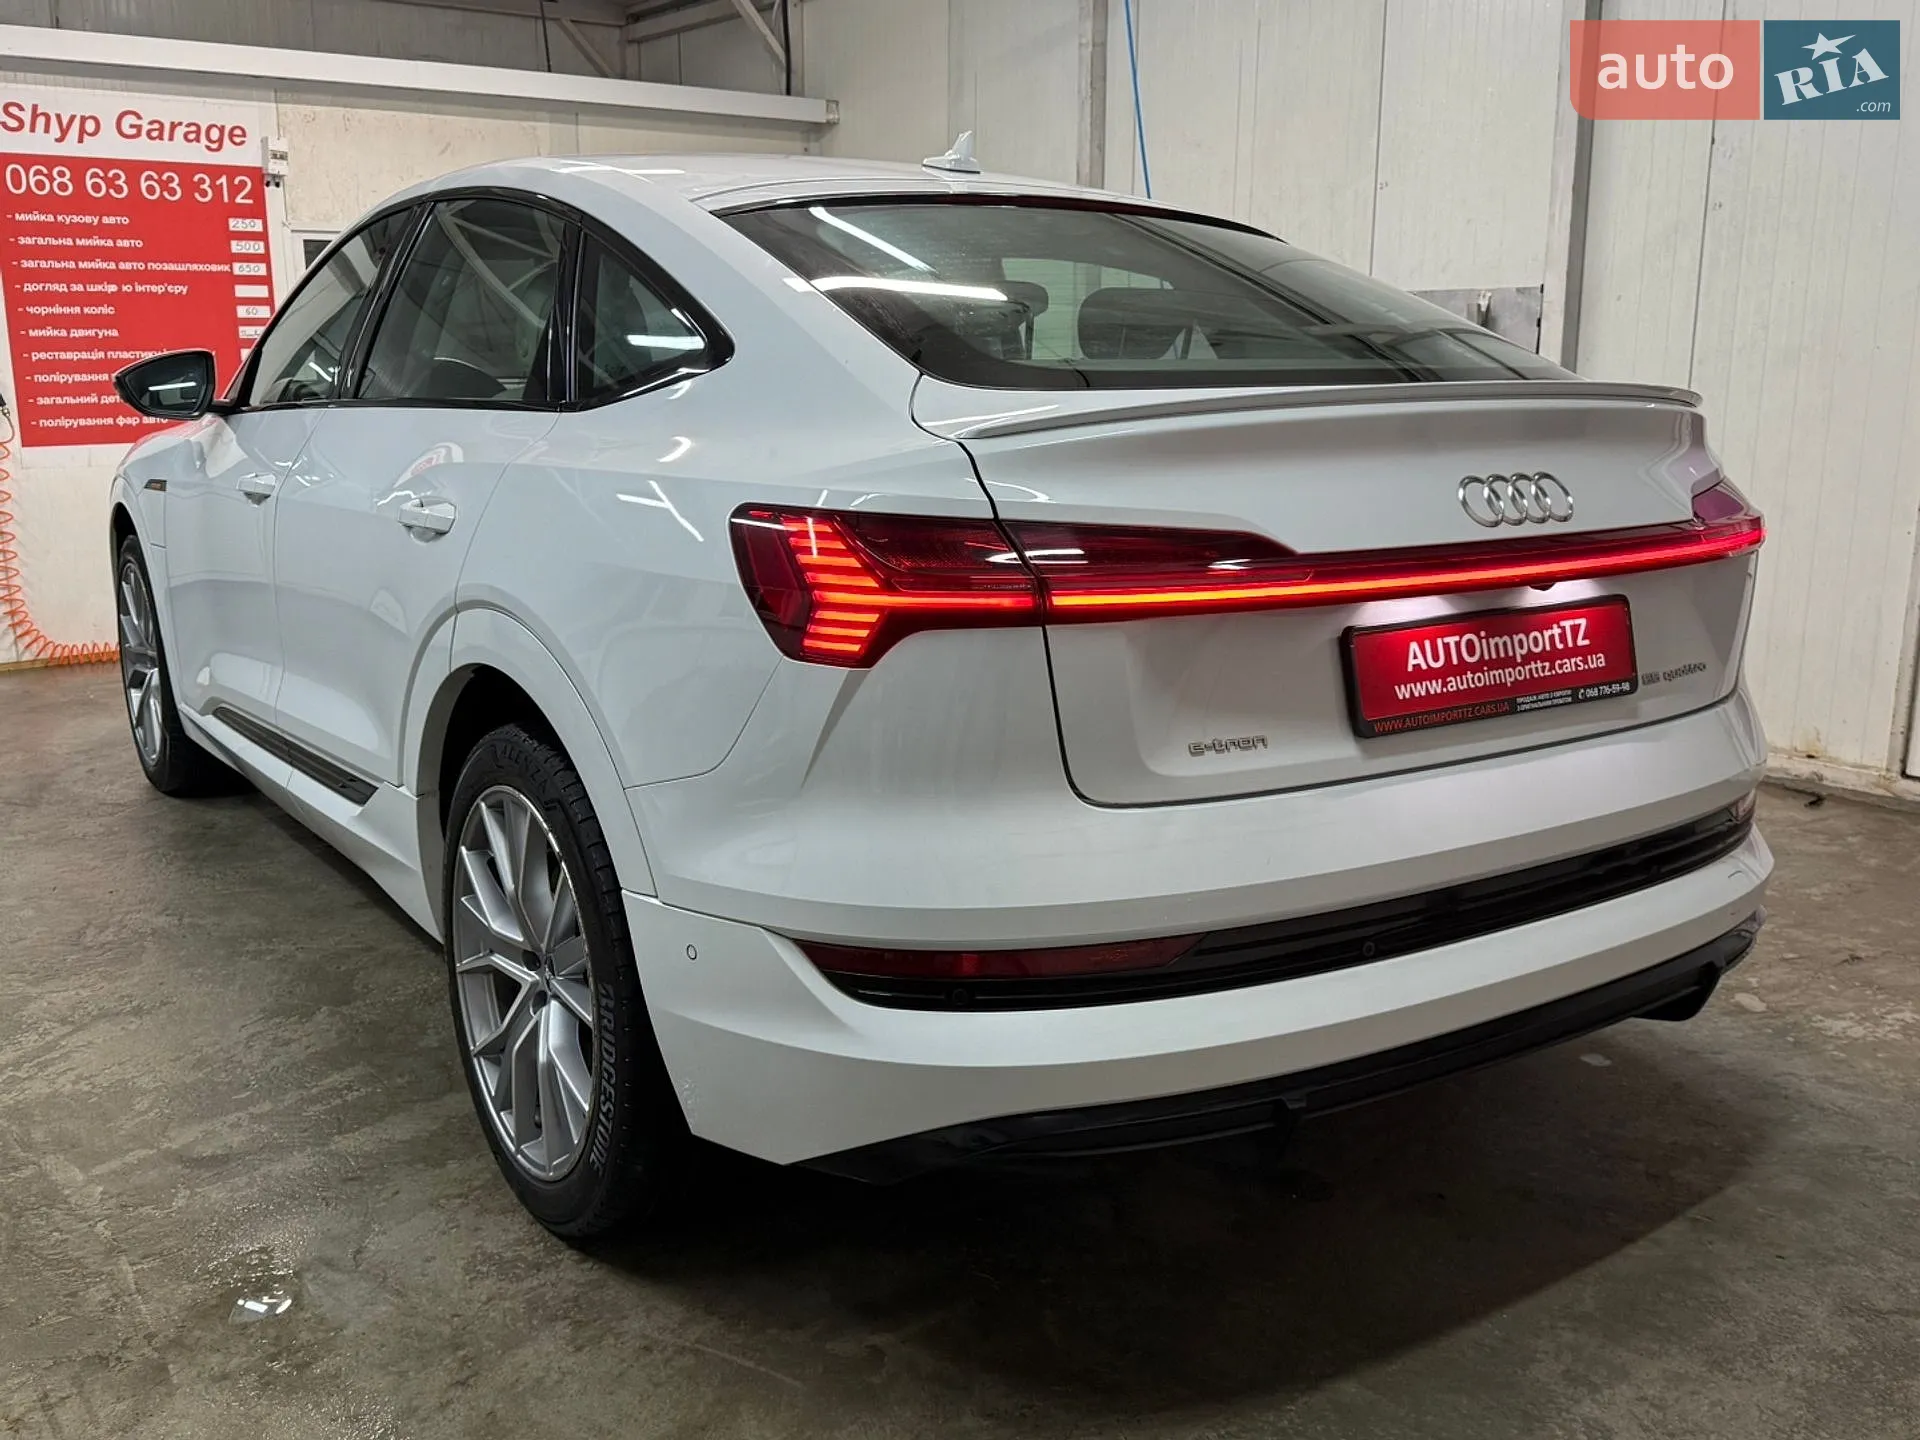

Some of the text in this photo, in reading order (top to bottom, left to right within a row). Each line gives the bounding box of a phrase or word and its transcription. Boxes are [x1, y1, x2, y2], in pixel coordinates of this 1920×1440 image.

[0, 101, 247, 152] Shyp Garage
[6, 164, 253, 203] 068 63 63 312
[15, 211, 54, 222] мийка
[57, 215, 99, 225] кузову
[102, 216, 129, 224] авто
[231, 219, 256, 229] 250
[18, 237, 73, 245] загальна
[76, 236, 114, 246] мийка
[116, 239, 143, 247] авто
[235, 240, 261, 251] 500
[21, 260, 76, 268] загальна
[78, 259, 116, 269] мийка
[118, 262, 145, 270] авто
[147, 263, 231, 272] позашляховик
[238, 264, 260, 273] 650
[24, 283, 68, 292] догляд
[135, 282, 188, 295] інтер'єру
[26, 304, 81, 316] чорніння
[83, 304, 115, 314] коліс
[29, 327, 67, 337] мийка
[70, 329, 119, 338] двигуна
[32, 349, 105, 361] реставрація
[34, 372, 109, 384] полірування
[37, 393, 98, 405] загальний
[39, 416, 113, 428] полірування
[116, 416, 140, 426] фар
[1406, 618, 1591, 672] AUTOimportTZ
[1394, 650, 1605, 701] www.autoimporttz.cars.ua
[1188, 734, 1268, 757] e-tron
[589, 982, 616, 1177] BRIDGESTONE
